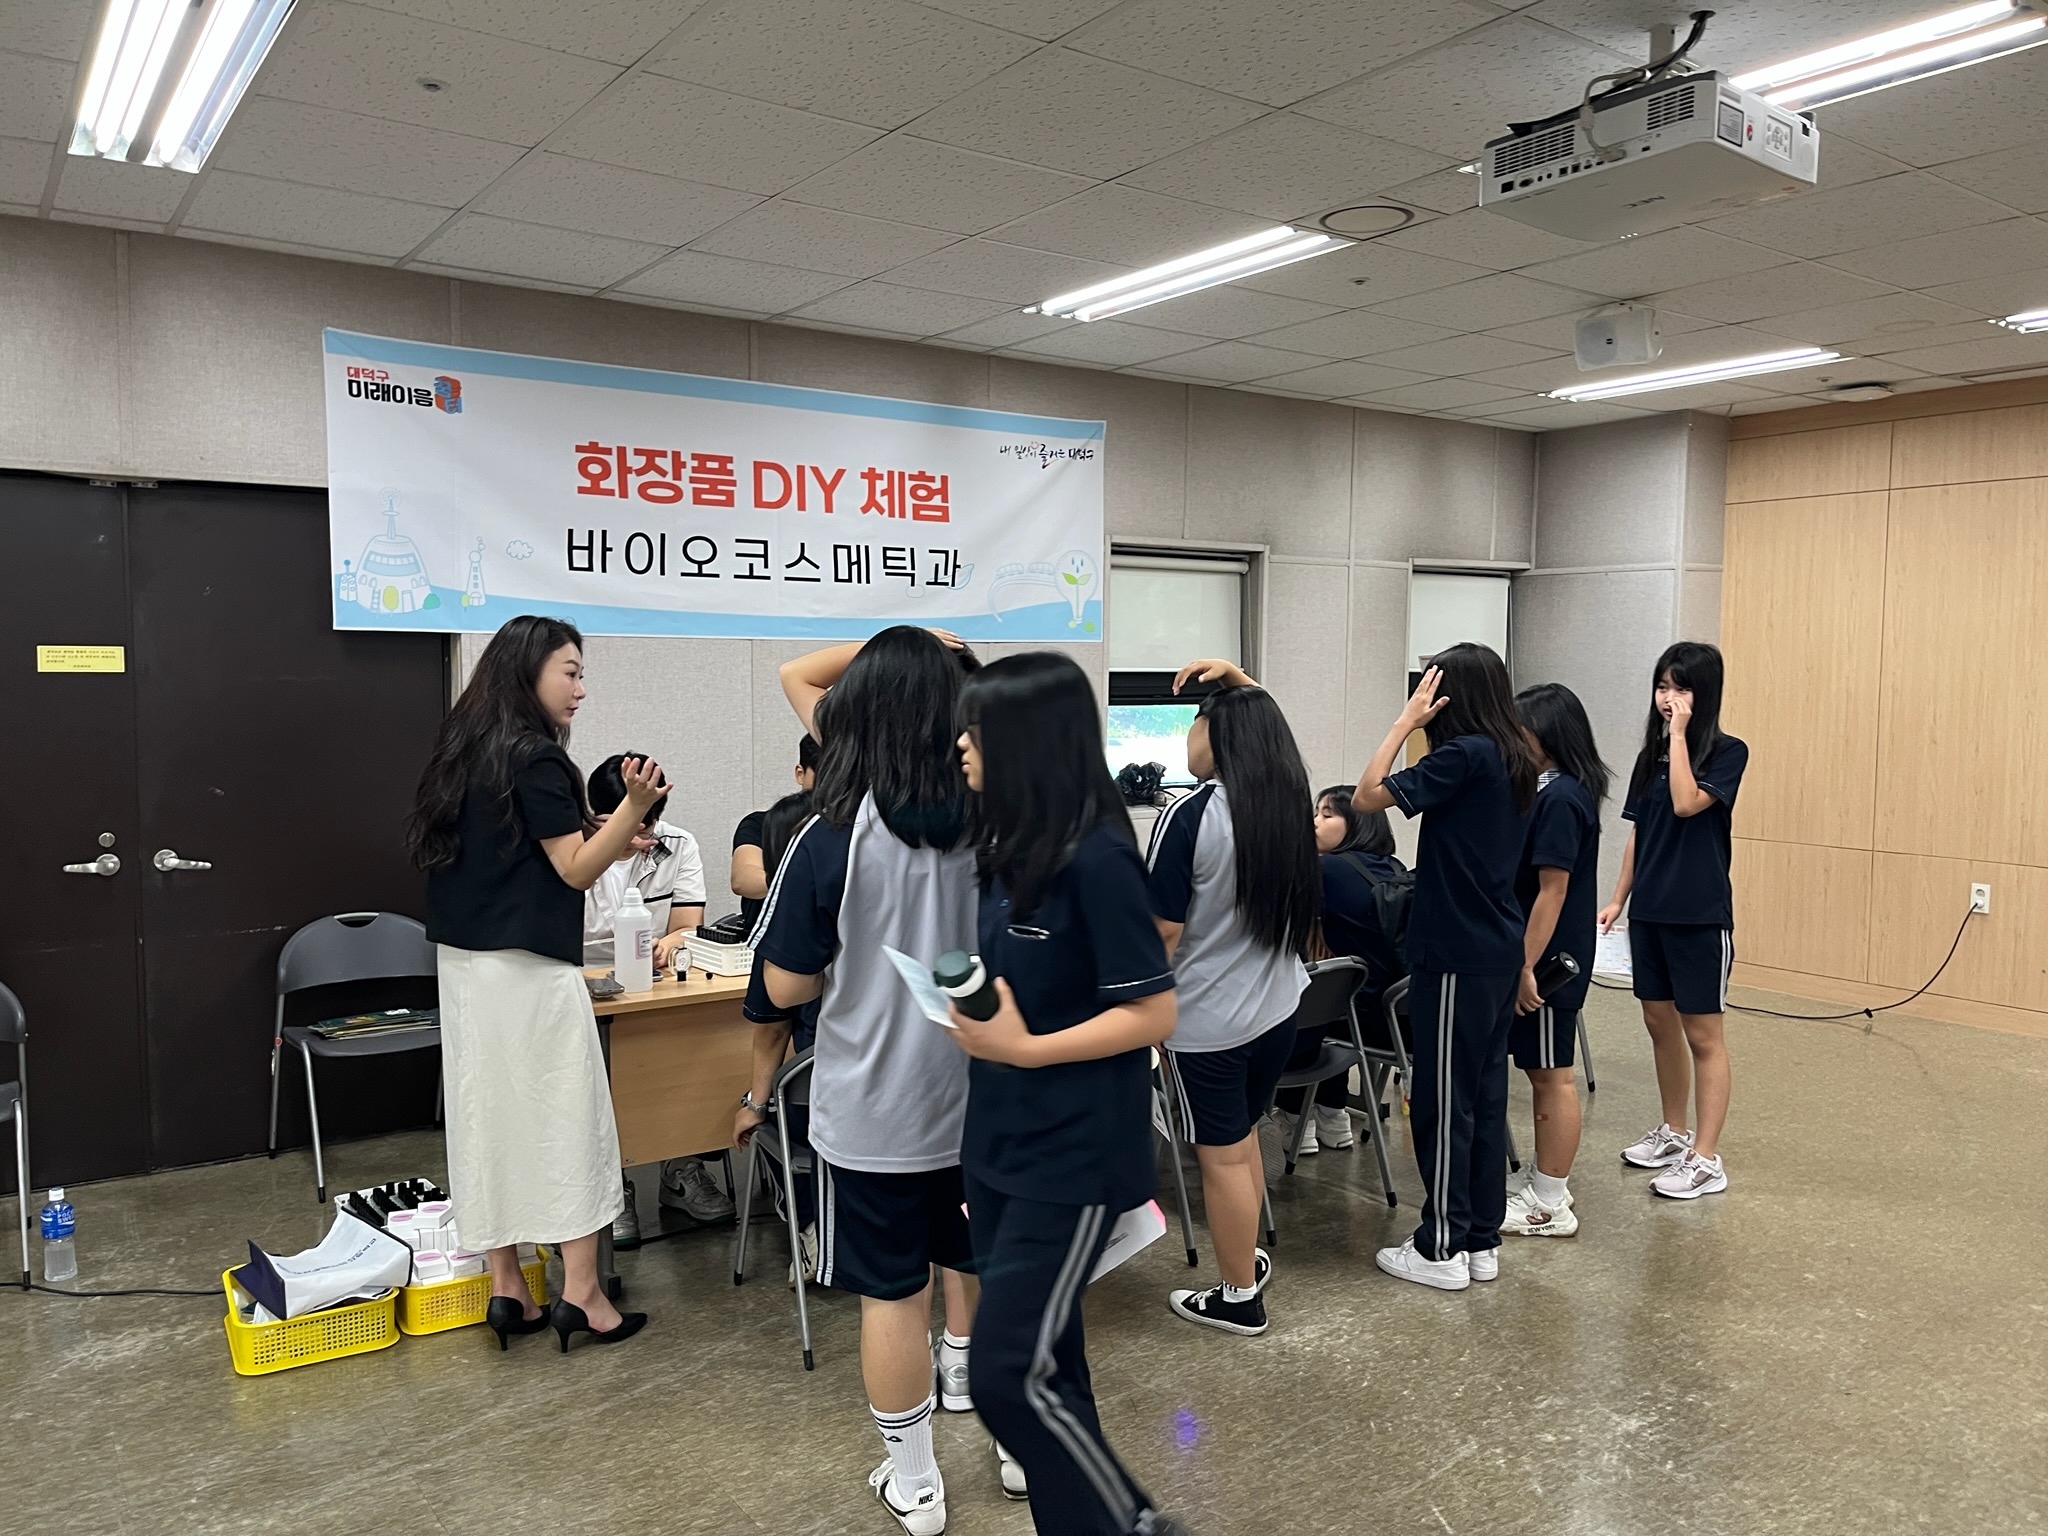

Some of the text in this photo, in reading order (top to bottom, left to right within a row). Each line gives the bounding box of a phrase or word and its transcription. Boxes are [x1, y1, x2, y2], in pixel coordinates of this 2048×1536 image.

[347, 366, 389, 382] 대덕구
[347, 379, 433, 407] 미래이음
[999, 445, 1011, 456] 내
[1068, 447, 1094, 461] 대덕구
[574, 440, 951, 523] 화장품 DIY 체험
[567, 527, 962, 588] 바이오코스메틱과
[918, 1492, 934, 1505] NIKE
